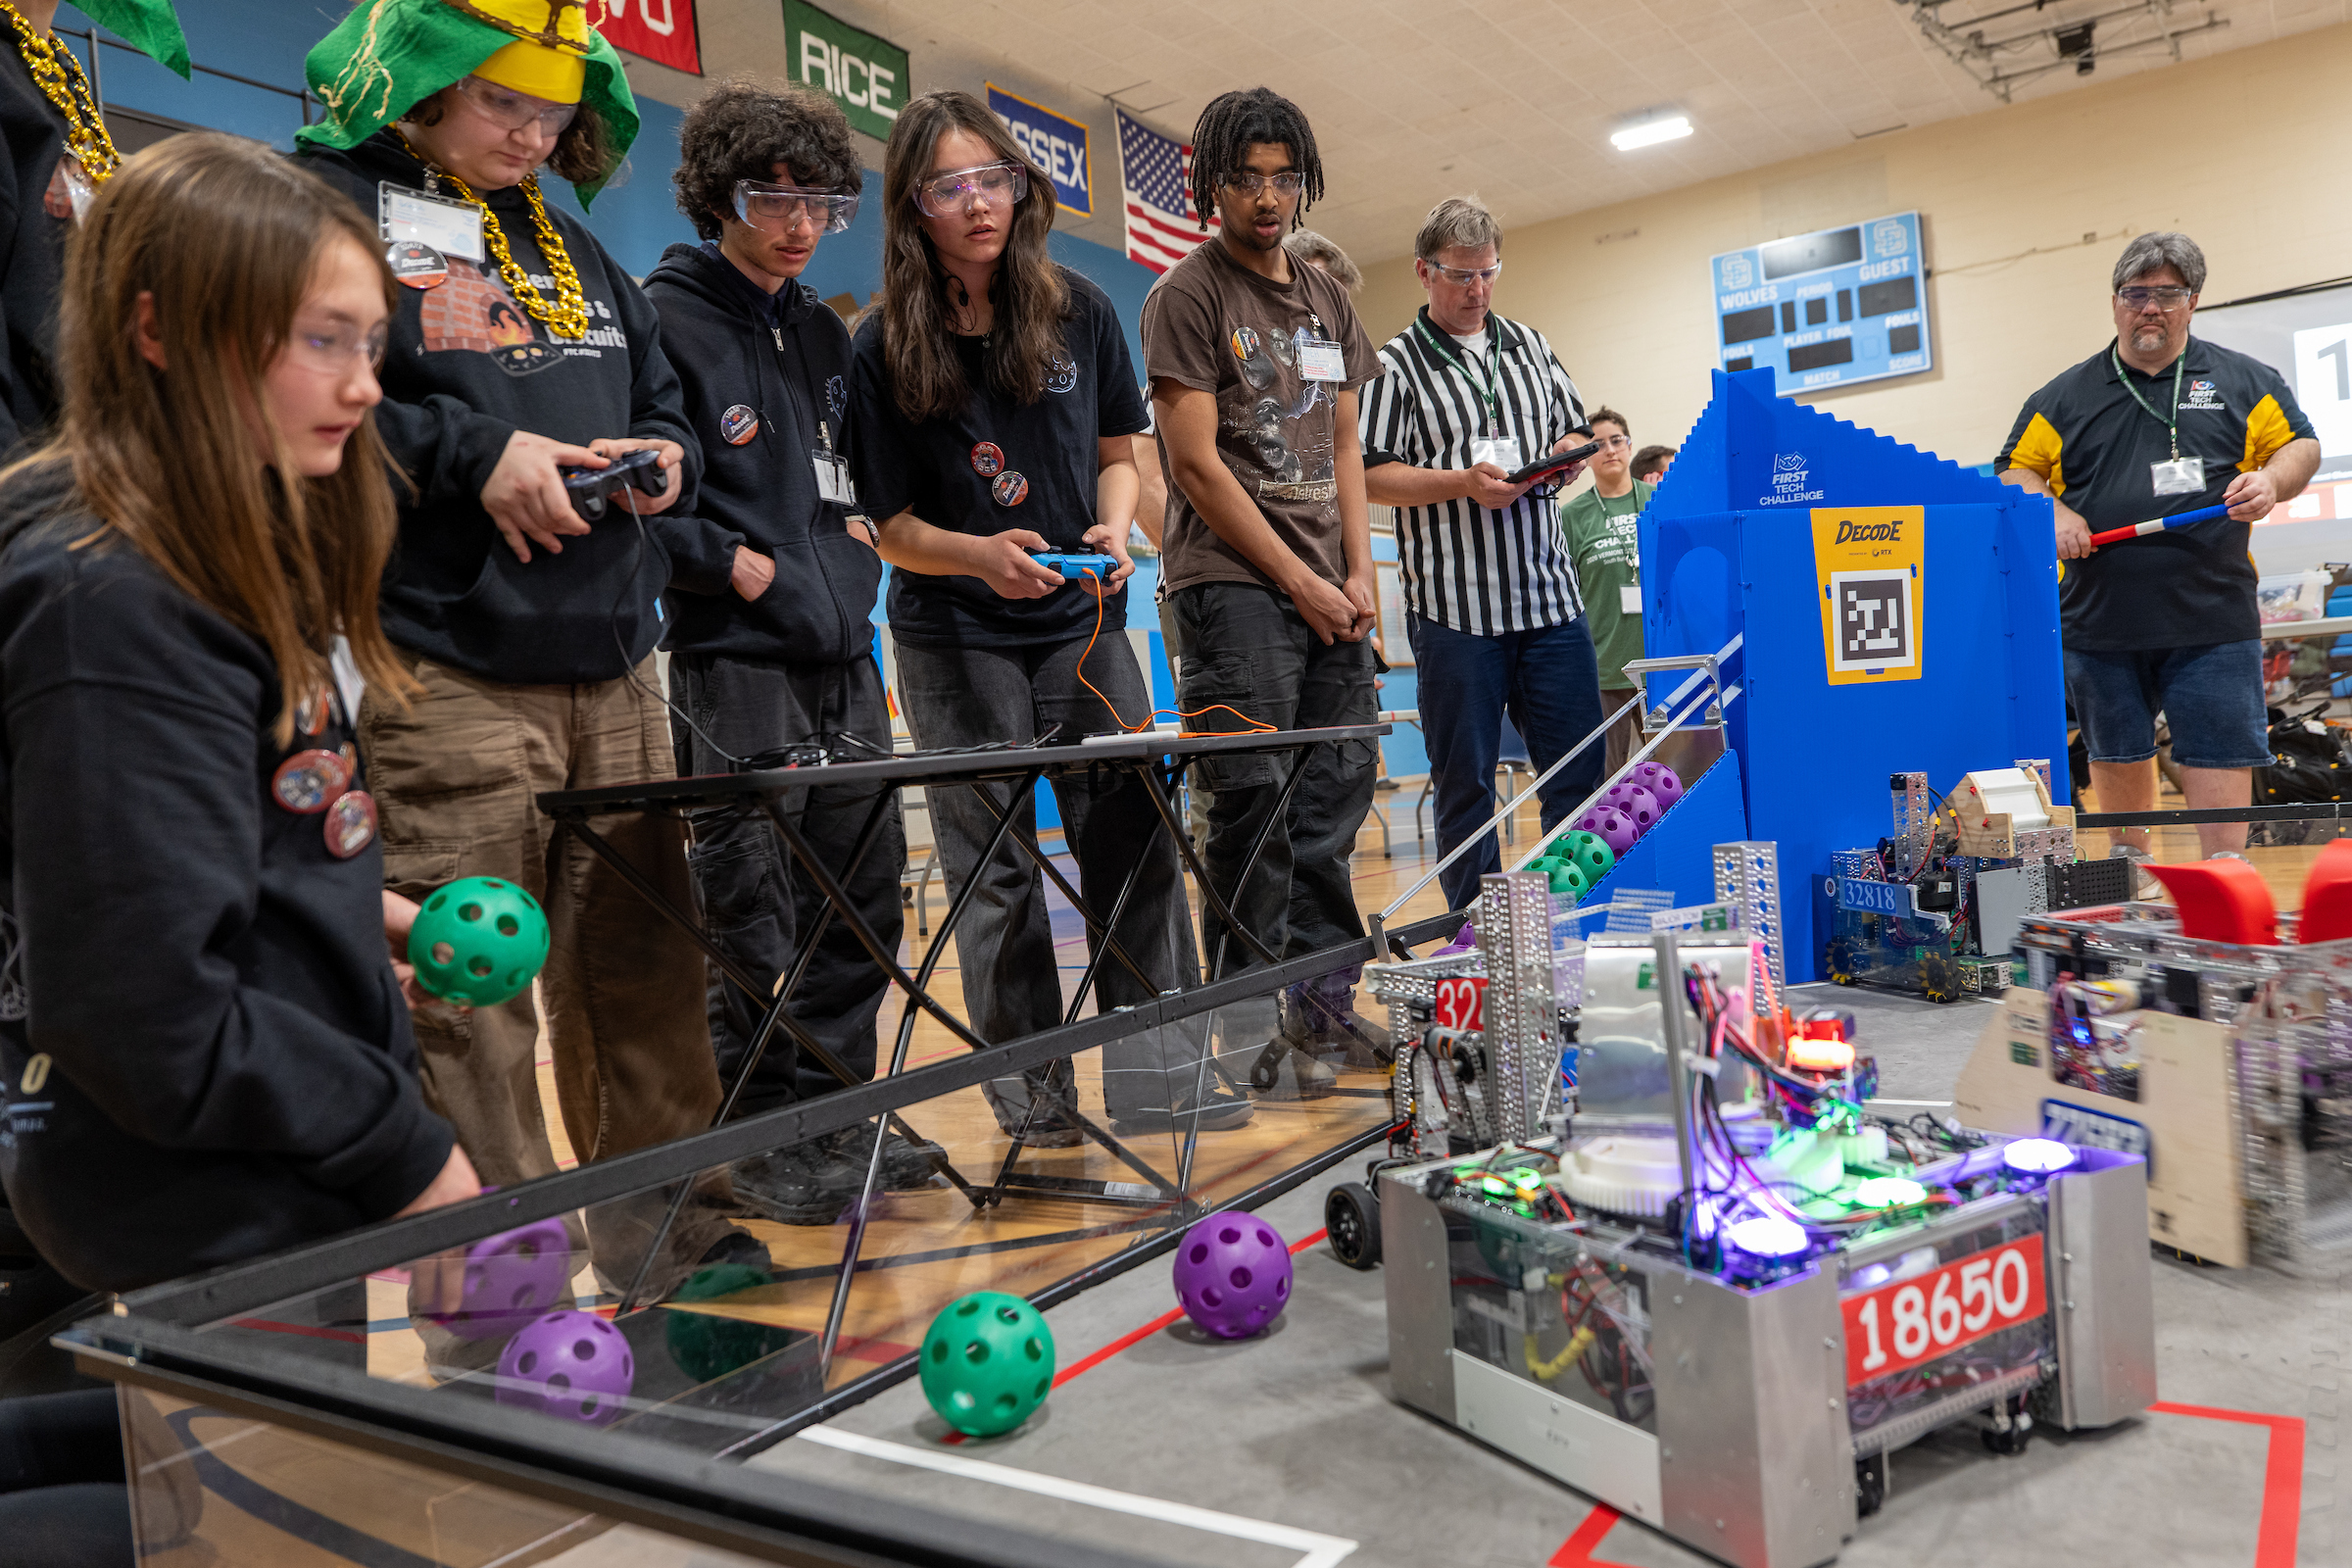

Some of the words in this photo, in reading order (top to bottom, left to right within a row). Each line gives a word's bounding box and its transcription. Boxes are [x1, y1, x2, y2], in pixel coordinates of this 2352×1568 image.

[800, 29, 899, 121] RICE
[994, 112, 1087, 192] SSEX
[1859, 256, 1910, 281] GUEST
[1720, 285, 1778, 310] WOLVES
[1795, 281, 1834, 299] PERIOD
[1885, 311, 1920, 329] FOULS
[544, 324, 627, 349] Bcuits
[1783, 330, 1823, 349] PLAYER
[1827, 324, 1853, 340] FOUL
[1722, 344, 1754, 360] FOULS
[1888, 354, 1923, 371] SCORE
[1803, 370, 1840, 386] MATCH
[2178, 402, 2225, 411] CHALLENGE
[1772, 470, 1809, 485] FIRST
[1775, 483, 1804, 494] TECH
[1759, 490, 1824, 506] CHALLENGE
[1605, 513, 1639, 529] FIRS
[1835, 520, 1904, 545] DECODE
[1597, 548, 1624, 560] VERMONT
[1845, 882, 1895, 910] 32818
[1858, 1248, 2030, 1371] 18650
